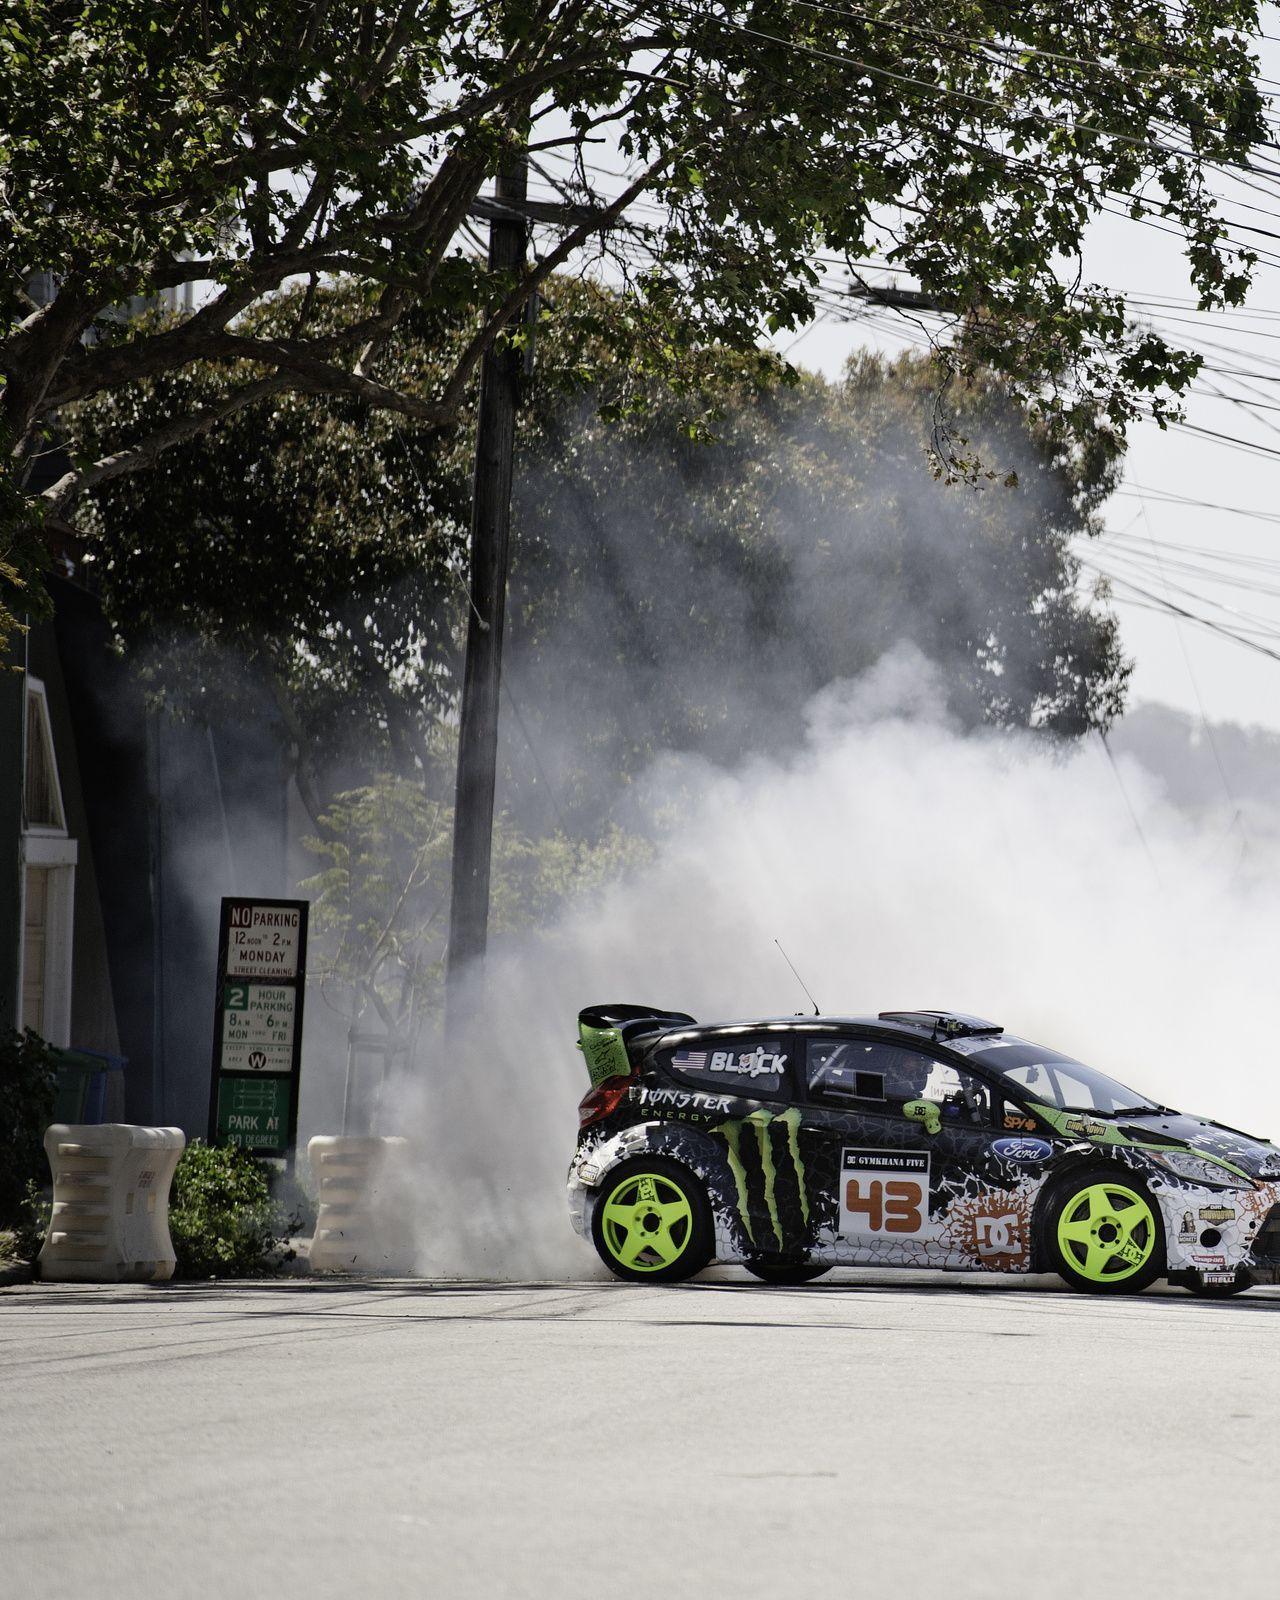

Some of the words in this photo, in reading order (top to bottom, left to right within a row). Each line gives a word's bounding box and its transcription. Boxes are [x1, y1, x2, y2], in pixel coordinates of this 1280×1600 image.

[231, 907, 251, 926] NO
[253, 912, 298, 927] PARKING
[235, 931, 246, 945] 12
[272, 933, 280, 945] 2
[240, 950, 285, 963] MONDAY
[234, 966, 257, 974] STREET
[259, 967, 293, 976] CLEANING
[229, 988, 244, 1006] 2
[258, 990, 286, 1001] HOUR
[250, 1001, 293, 1012] PARKING
[229, 1012, 237, 1026] 8
[266, 1014, 274, 1028] 6
[228, 1030, 248, 1039] MON
[272, 1031, 287, 1041] FRI
[250, 1054, 265, 1068] W
[710, 1048, 788, 1077] BLOCK
[641, 1108, 712, 1122] ENERGY
[228, 1115, 259, 1130] PARK
[266, 1116, 279, 1130] AT
[1003, 1116, 1026, 1130] SPY
[246, 1134, 279, 1145] DEGREES
[1003, 1140, 1042, 1159] Ford
[858, 1156, 904, 1166] GYMKHANA
[906, 1158, 925, 1167] FIVE
[846, 1179, 922, 1234] 43
[974, 1213, 1023, 1256] DC
[1204, 1272, 1236, 1283] PIRELLI
